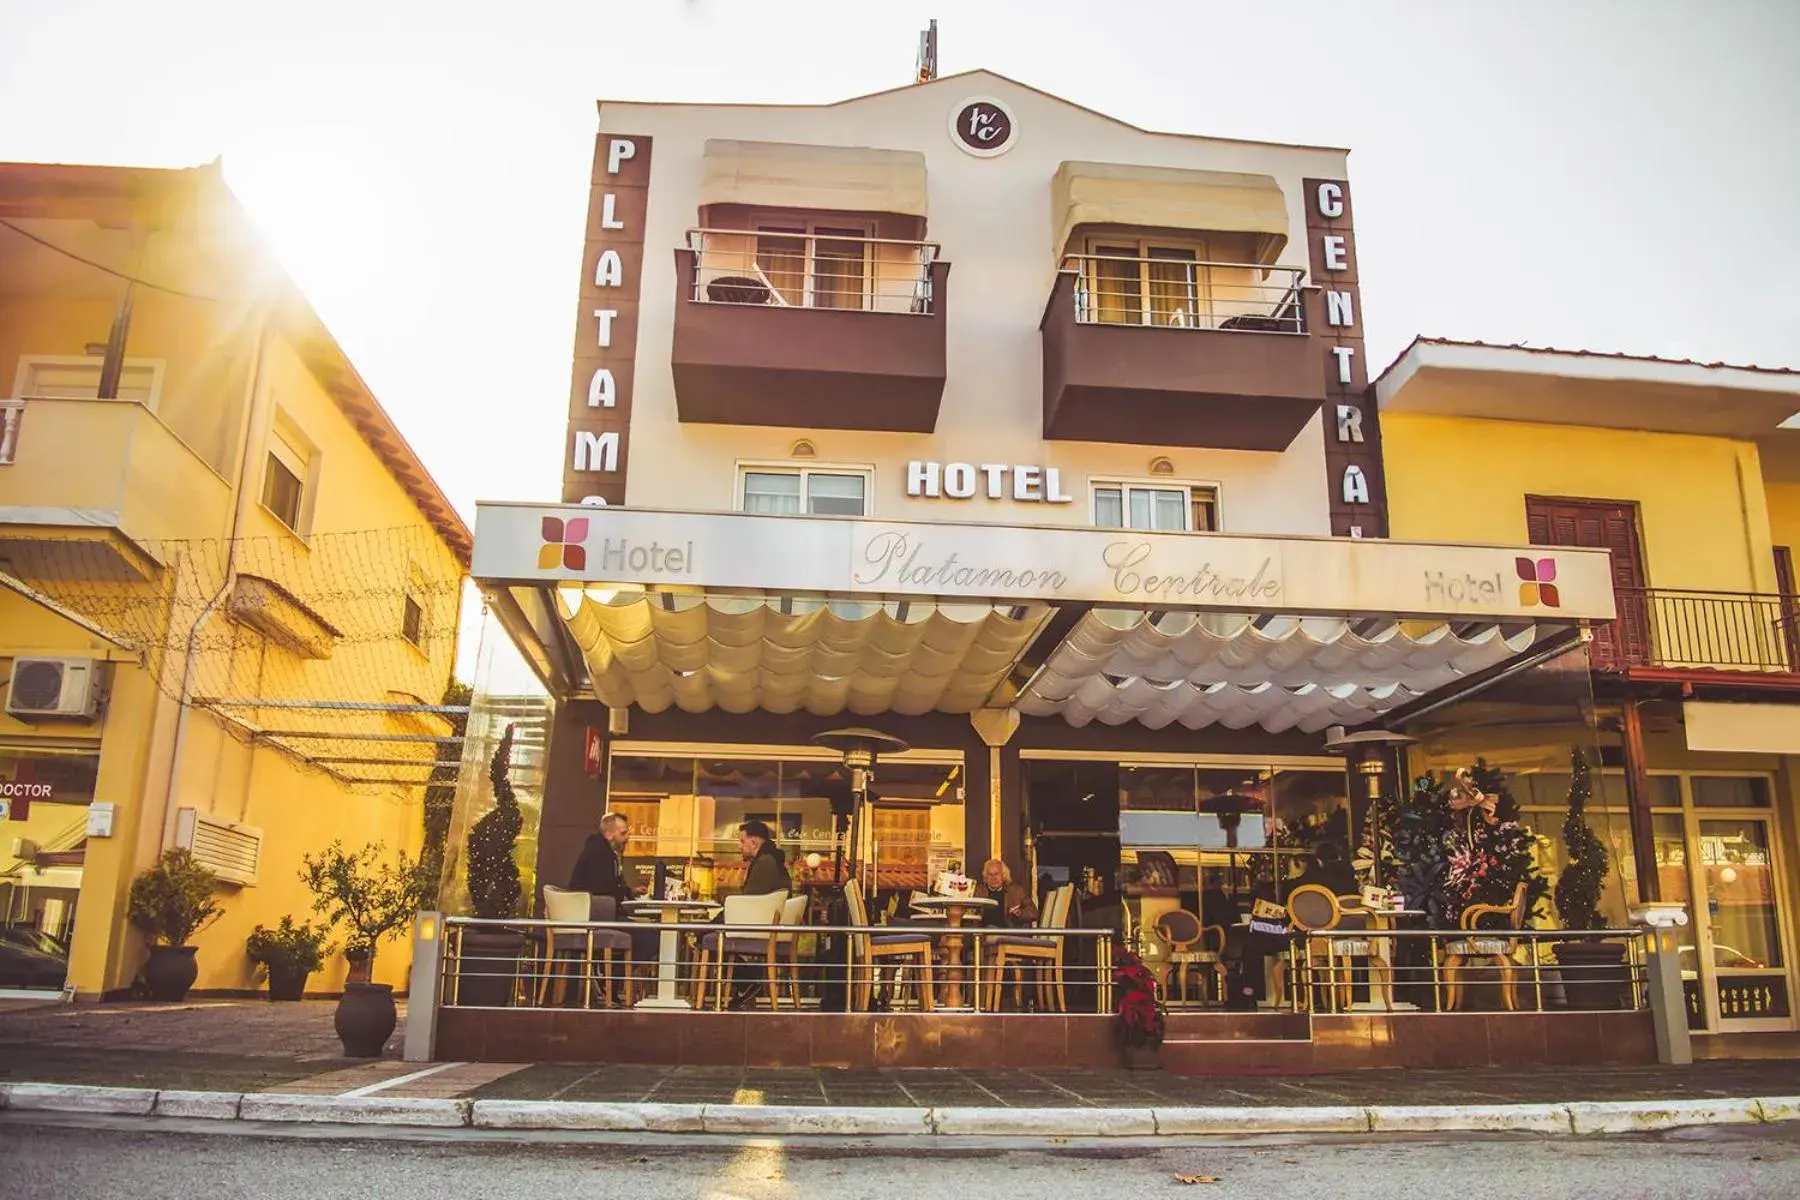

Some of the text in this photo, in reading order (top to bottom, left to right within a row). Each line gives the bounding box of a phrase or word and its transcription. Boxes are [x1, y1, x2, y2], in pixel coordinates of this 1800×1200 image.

[573, 139, 636, 505] PLATAM
[1317, 183, 1369, 538] CENTRA
[906, 460, 1073, 503] HOTEL
[602, 538, 694, 575] Hotel
[854, 531, 1282, 599] Platamon Centrale
[1424, 570, 1503, 604] Hotel
